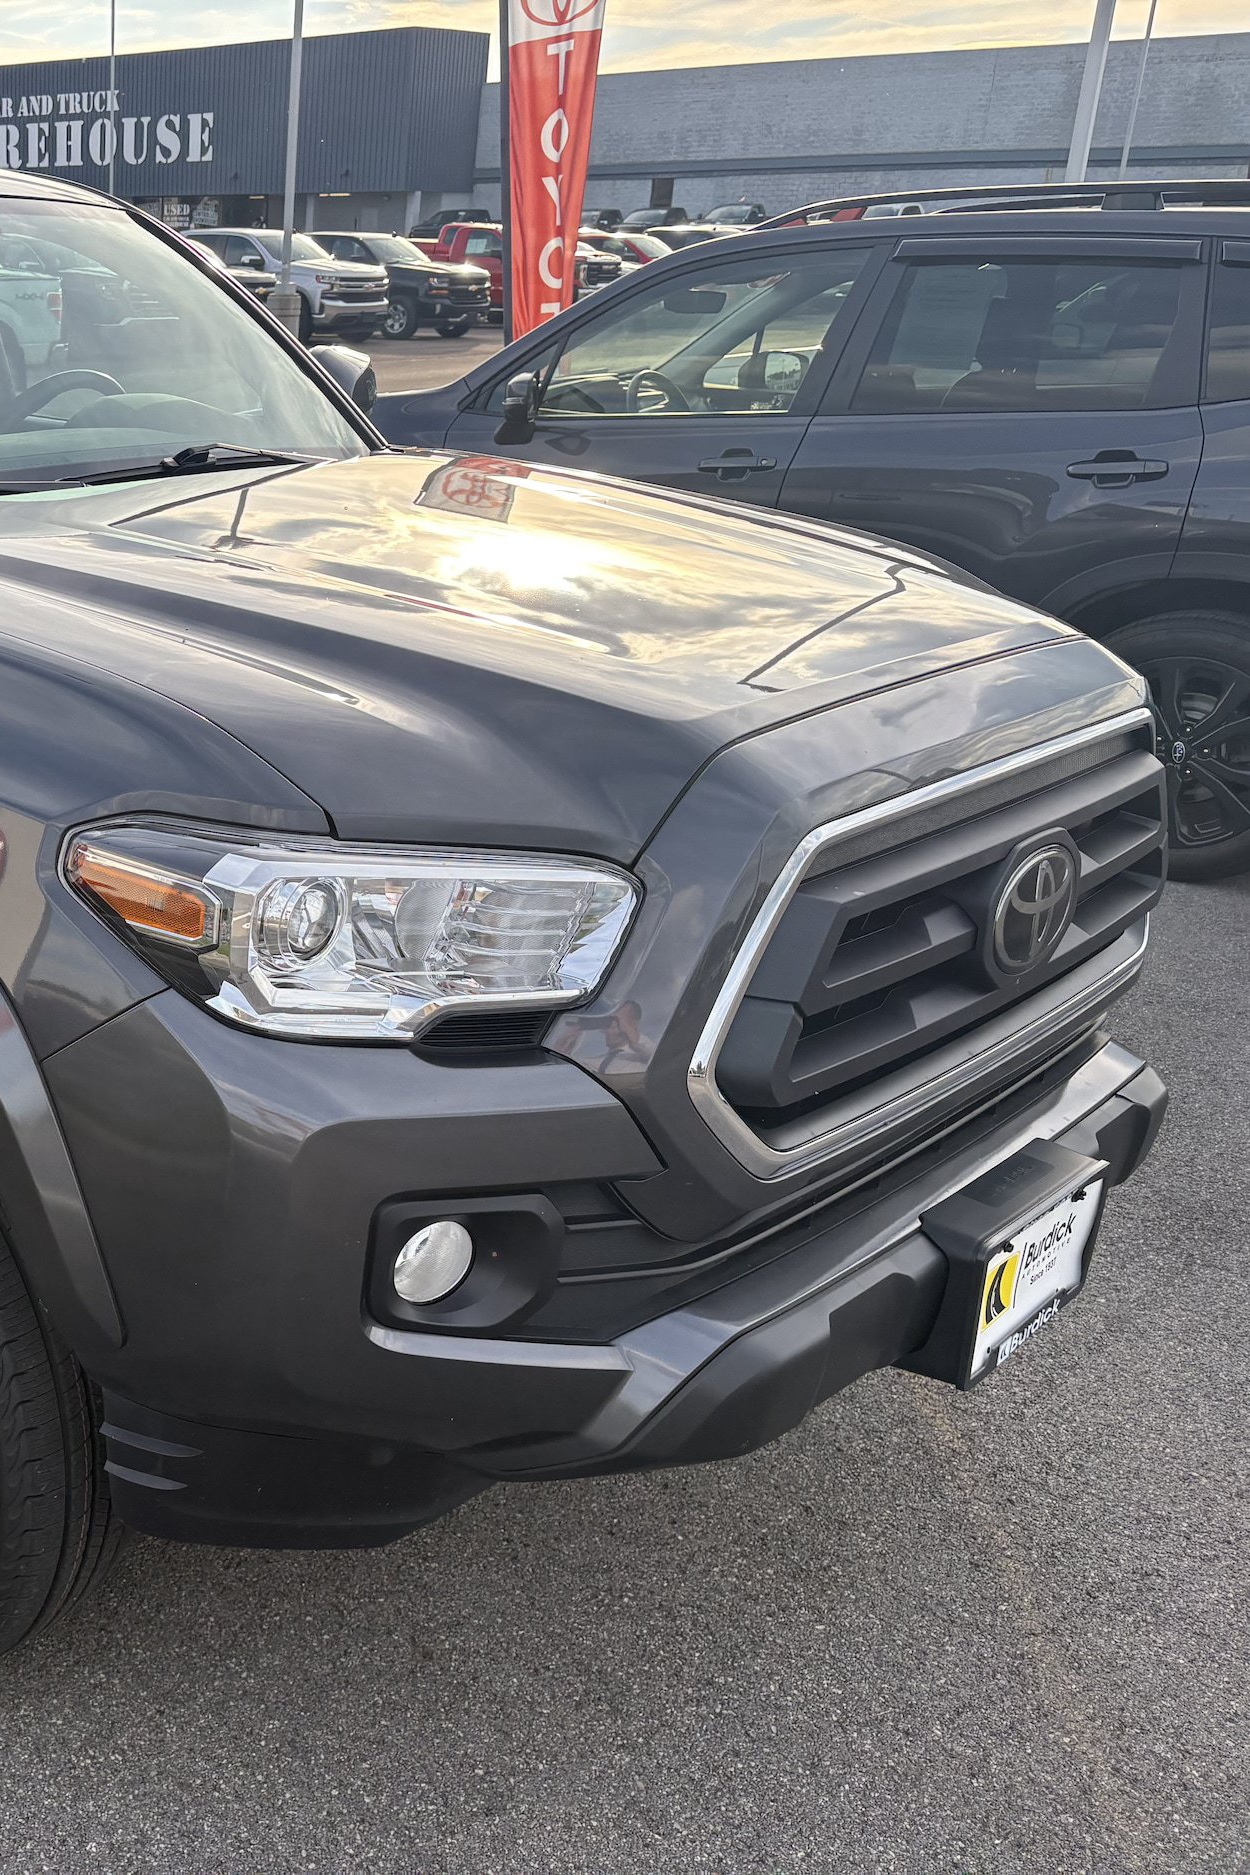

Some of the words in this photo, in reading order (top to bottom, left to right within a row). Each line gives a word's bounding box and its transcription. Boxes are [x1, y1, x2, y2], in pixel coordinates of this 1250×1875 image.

[17, 94, 54, 117] AND
[56, 90, 120, 115] TRUCK
[163, 204, 190, 216] USED
[1024, 1212, 1077, 1271] Burdick
[1021, 1238, 1071, 1280] AUTOMOTIVE
[1029, 1269, 1044, 1285] Since
[1010, 1299, 1061, 1352] Burdick
